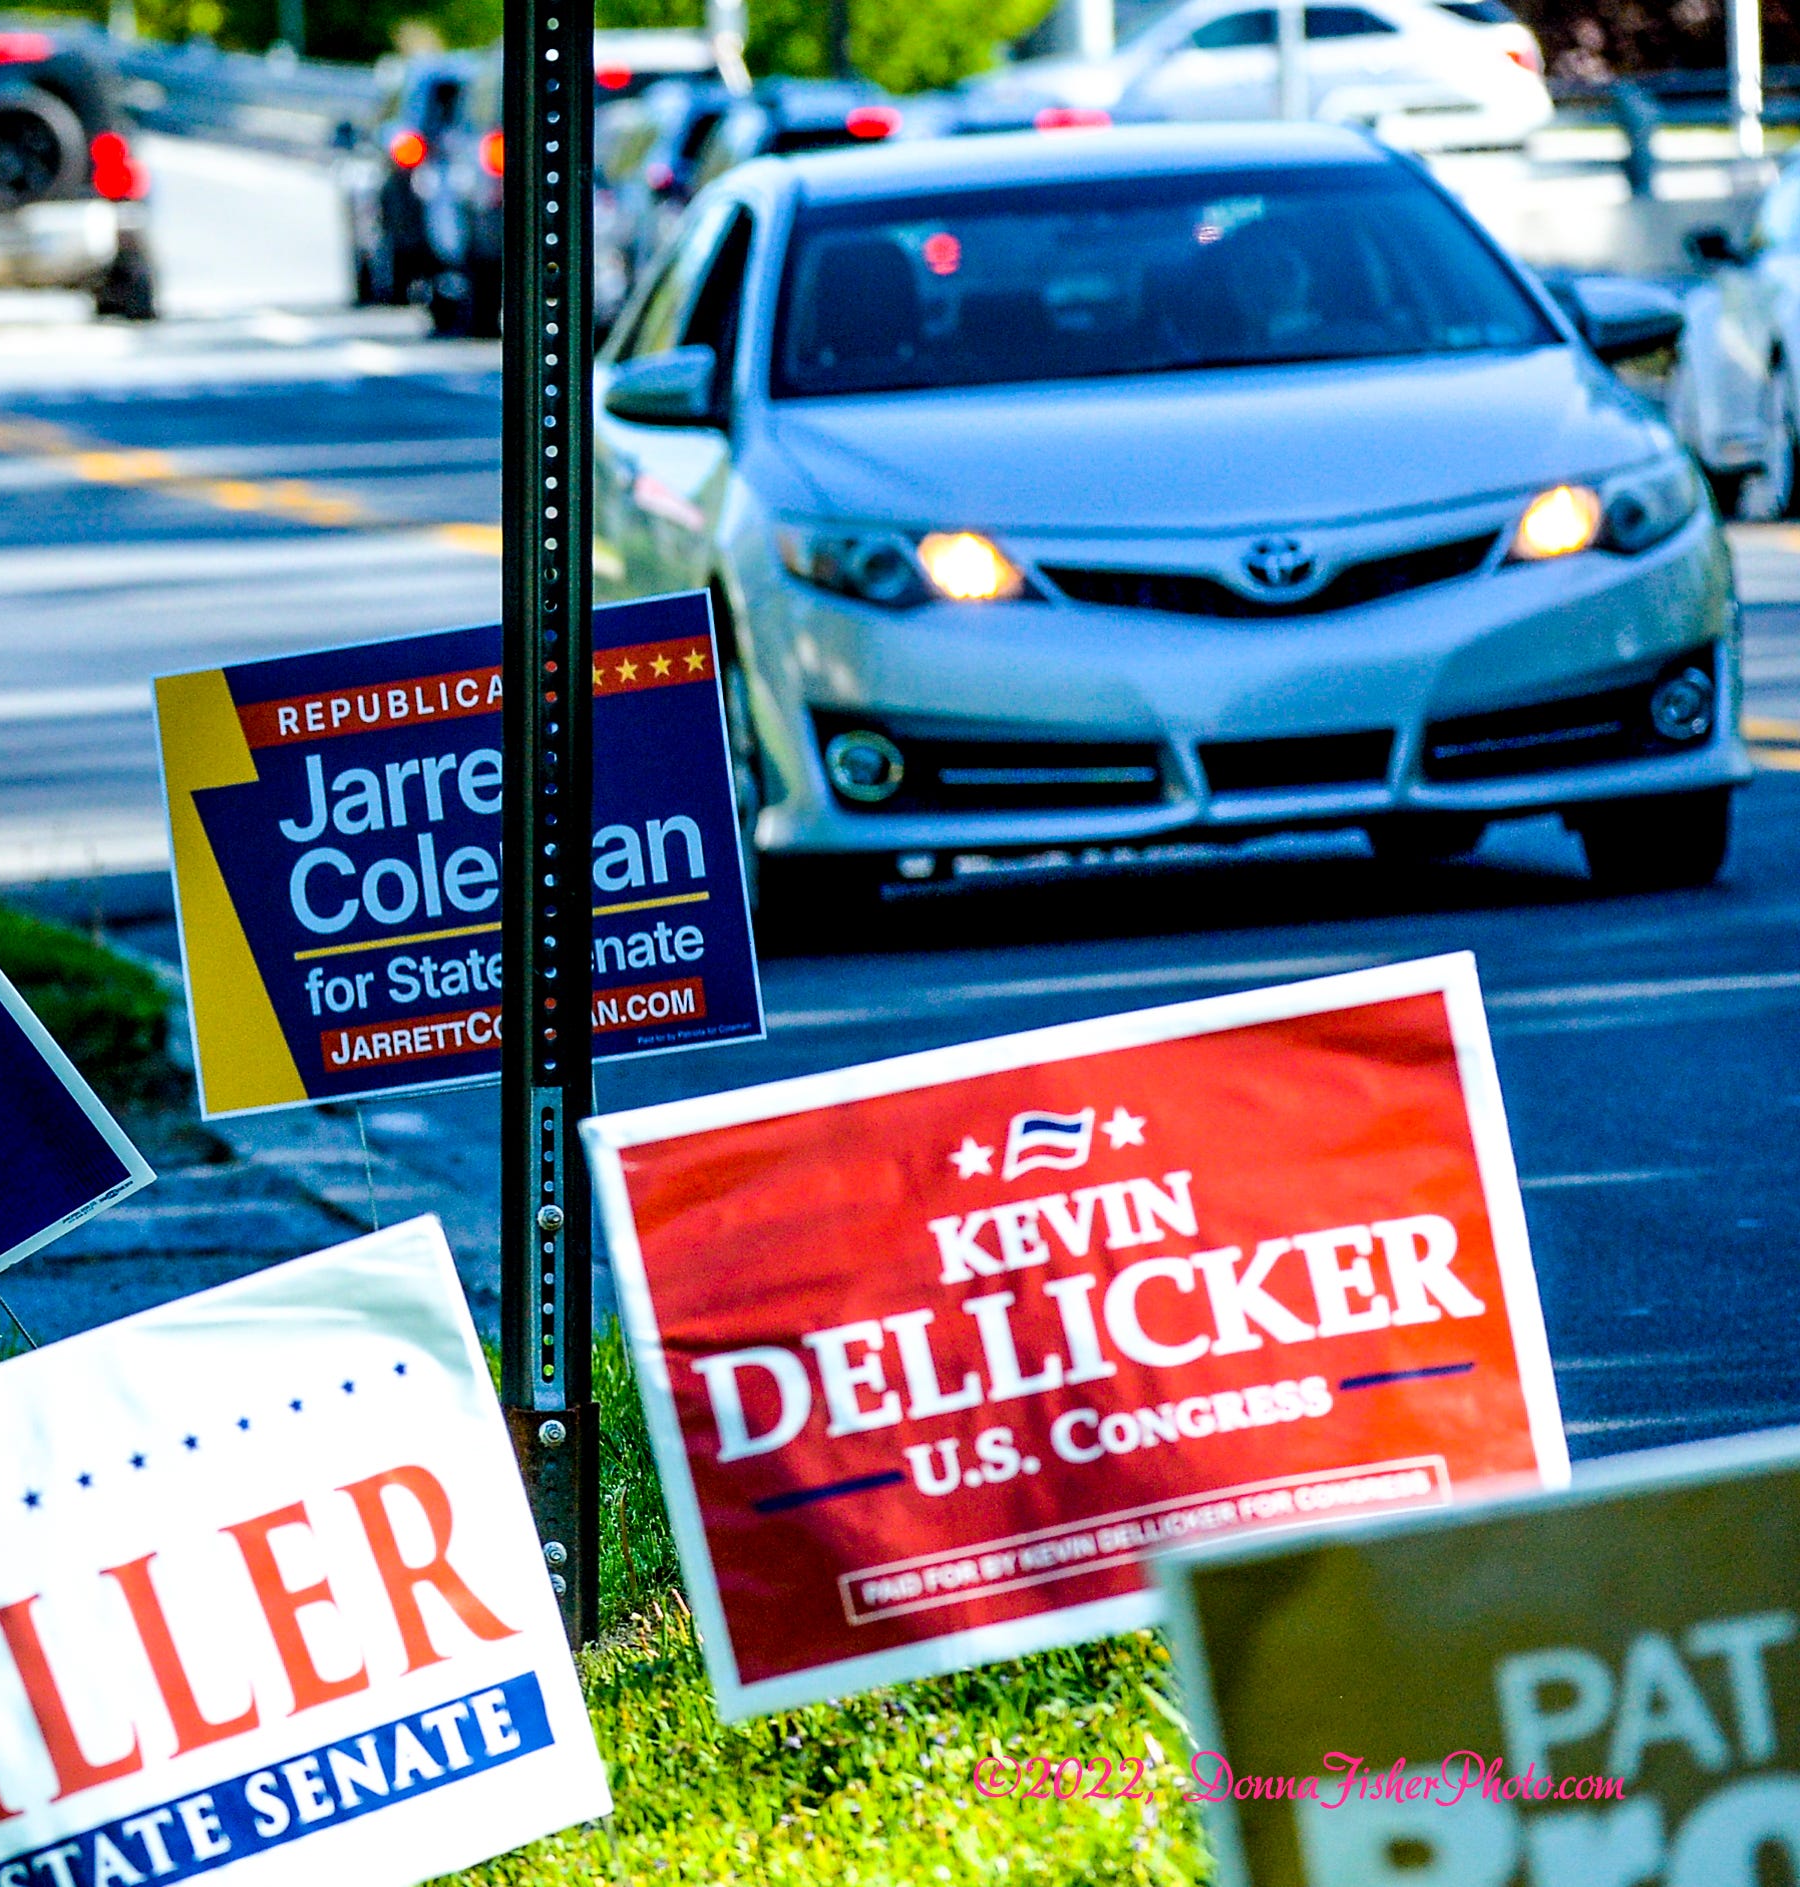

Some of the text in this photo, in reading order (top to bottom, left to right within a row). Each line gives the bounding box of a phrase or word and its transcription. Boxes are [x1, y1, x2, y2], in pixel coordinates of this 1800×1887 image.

[278, 672, 504, 736] REPUBLICA
[278, 747, 504, 843] Jarre
[289, 813, 708, 934] Colean
[304, 966, 375, 1017] for
[590, 918, 706, 976] nate
[928, 1169, 1202, 1286] KEVIN
[692, 1213, 1488, 1464] DELLICKER
[904, 1376, 1333, 1498] U.S. CONGRESS
[921, 1559, 981, 1592] FOR
[1238, 1490, 1295, 1521] FOR
[1495, 1608, 1799, 1788] PAT
[245, 1688, 523, 1839] SENATE
